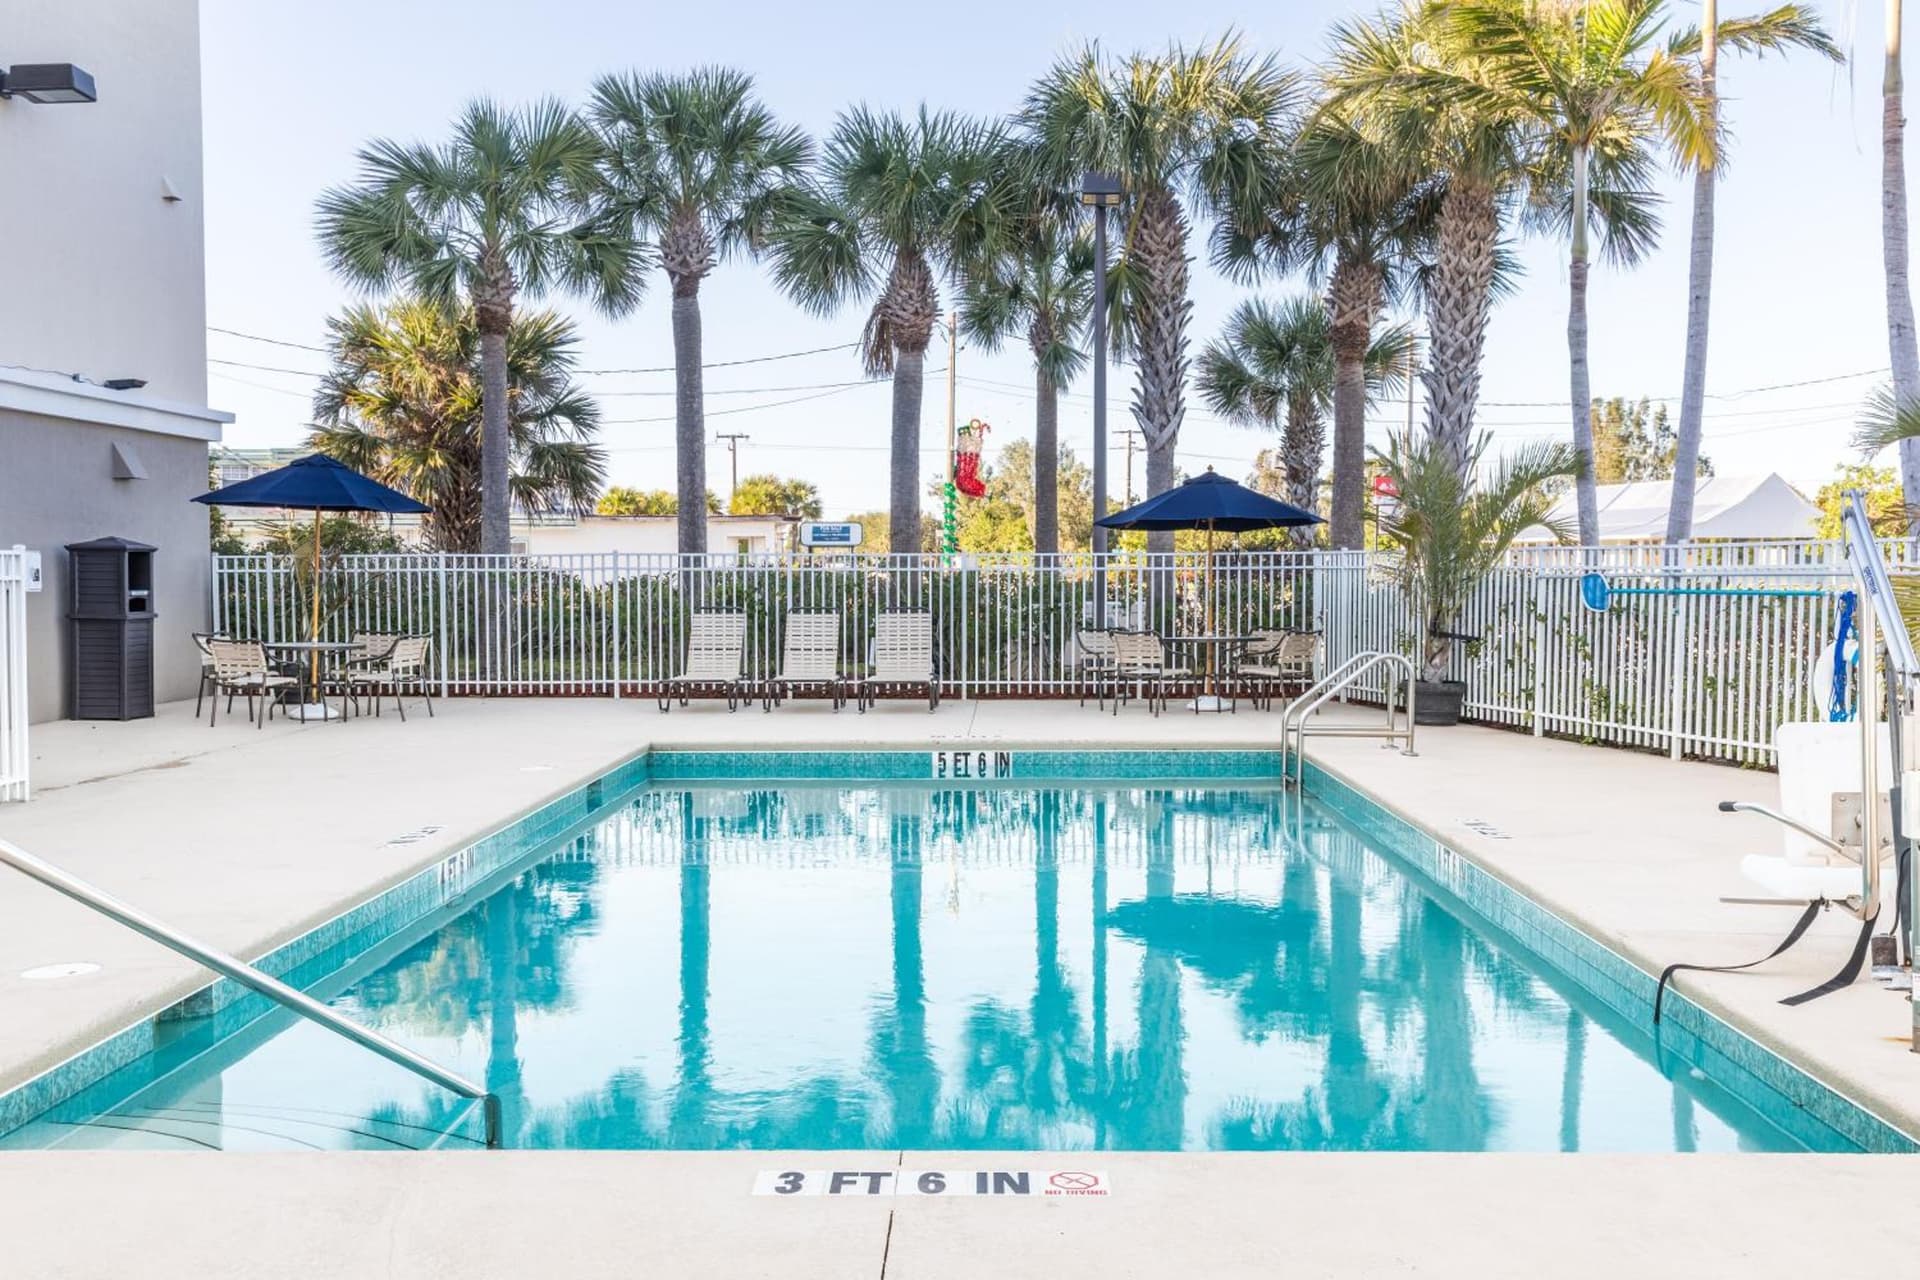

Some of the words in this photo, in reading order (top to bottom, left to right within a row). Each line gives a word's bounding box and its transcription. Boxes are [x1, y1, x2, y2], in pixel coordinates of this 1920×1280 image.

[994, 751, 1010, 776] IN
[774, 1171, 806, 1195] 3
[828, 1171, 893, 1195] FT
[916, 1171, 947, 1195] 6
[975, 1171, 1031, 1195] IN
